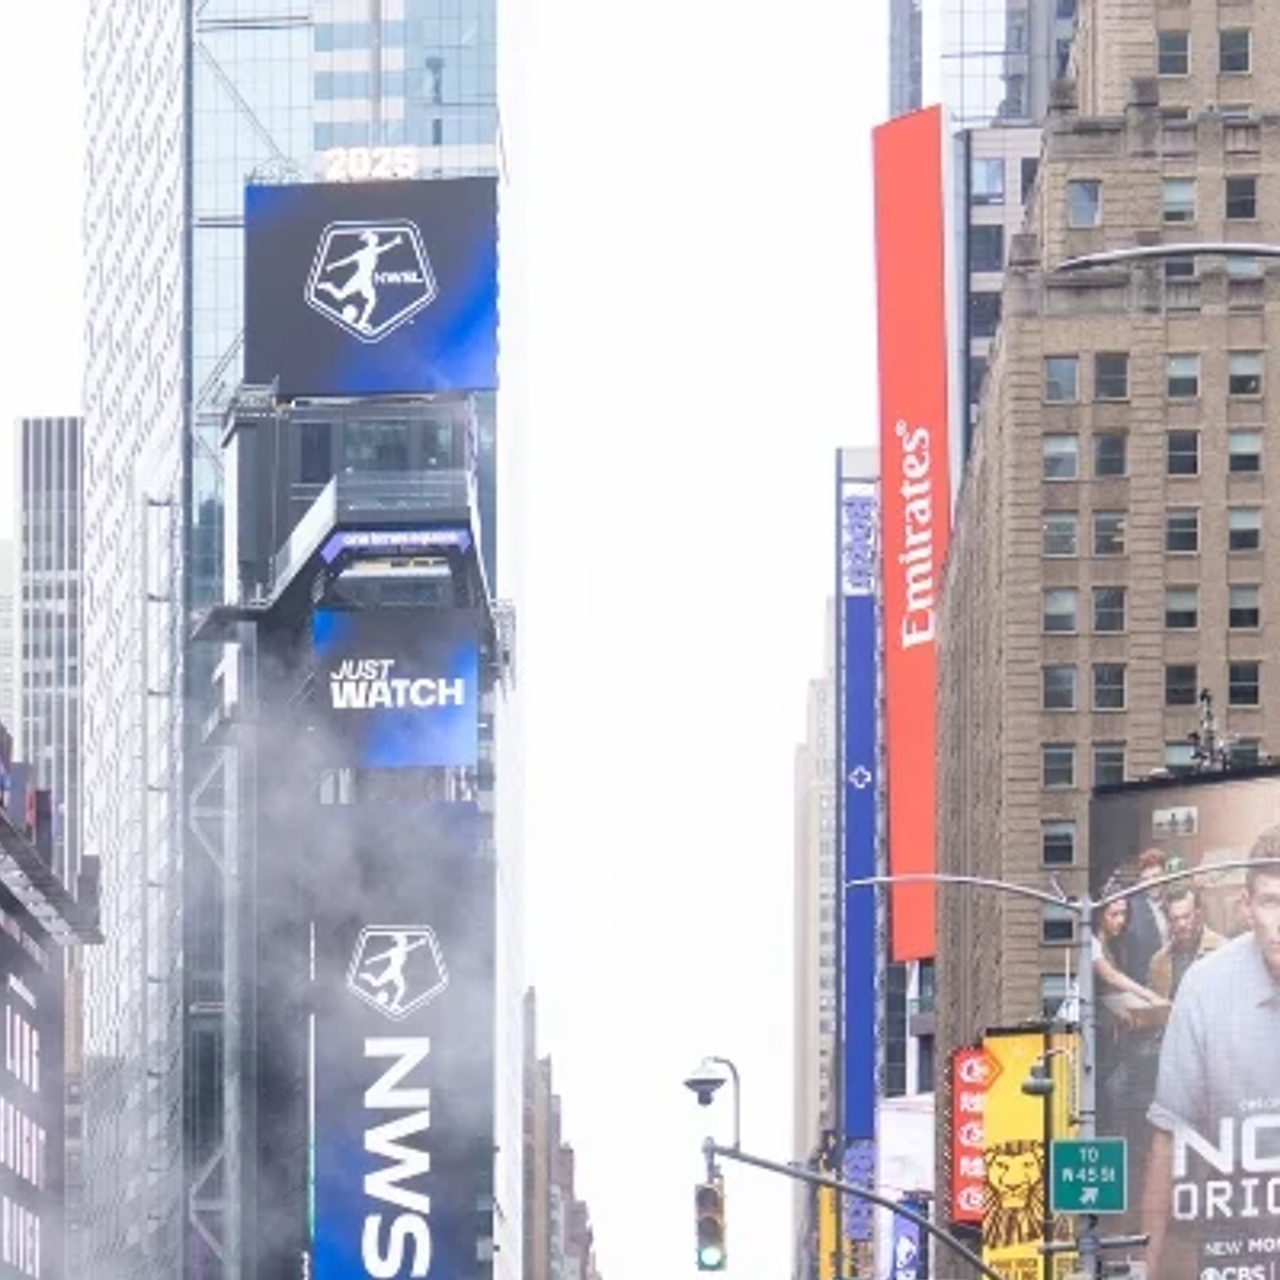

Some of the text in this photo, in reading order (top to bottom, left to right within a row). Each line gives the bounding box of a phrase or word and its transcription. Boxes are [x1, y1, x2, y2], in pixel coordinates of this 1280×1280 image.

[327, 148, 417, 183] 2025
[330, 659, 395, 680] JUST
[330, 679, 465, 709] WATCH
[1078, 1148, 1099, 1163] TO
[1206, 1242, 1242, 1257] NEW
